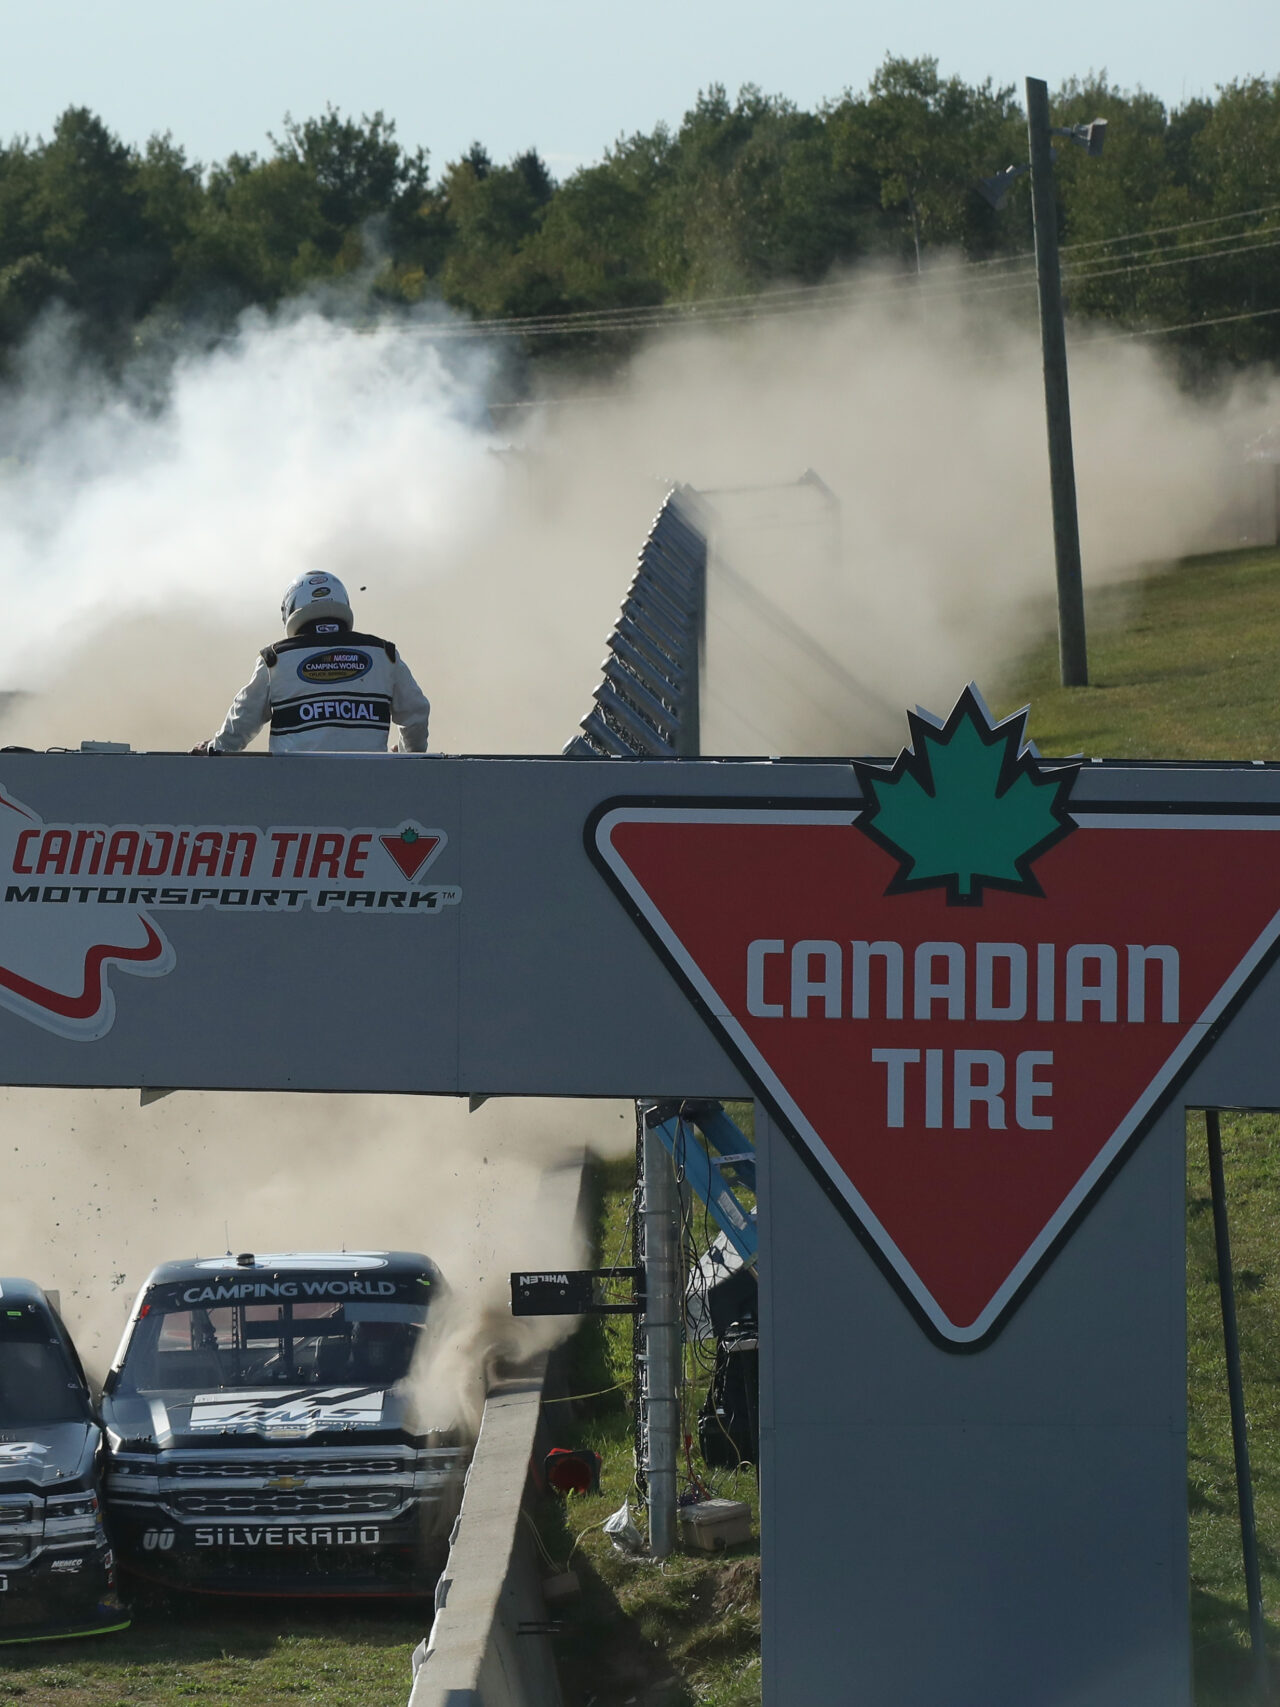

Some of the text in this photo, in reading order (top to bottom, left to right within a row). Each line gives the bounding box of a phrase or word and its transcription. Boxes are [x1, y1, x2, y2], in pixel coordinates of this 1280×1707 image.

[306, 662, 365, 671] CAMPING WORLD
[333, 654, 358, 662] NASCAR
[299, 701, 380, 720] OFFICIAL
[12, 829, 373, 878] CANADIAN TIRE
[5, 886, 308, 906] MOTORSPORT
[317, 890, 440, 908] PARK
[746, 938, 1181, 1024] CANADIAN
[870, 1047, 1055, 1131] TIRE
[183, 1280, 396, 1303] CAMPING WORLD
[519, 1274, 570, 1287] WHELEN
[143, 1526, 380, 1550] 00 SILVERADO
[51, 1559, 83, 1568] NEMCO
